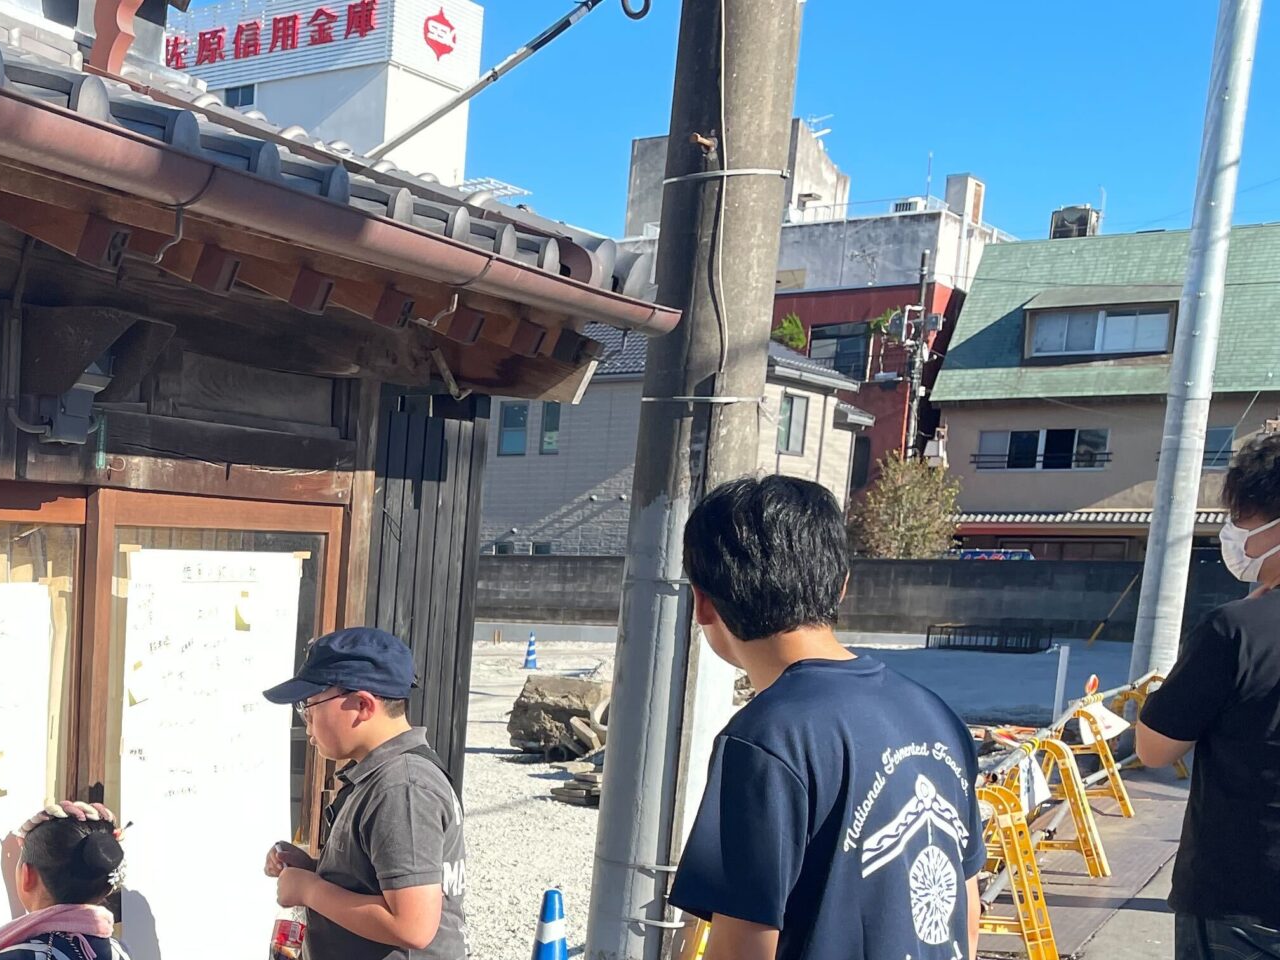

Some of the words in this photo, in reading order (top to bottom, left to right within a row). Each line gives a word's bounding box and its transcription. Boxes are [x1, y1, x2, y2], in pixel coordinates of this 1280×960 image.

[166, 0, 376, 69] 佐原信用金庫
[843, 771, 886, 852] National
[932, 741, 962, 778] Food
